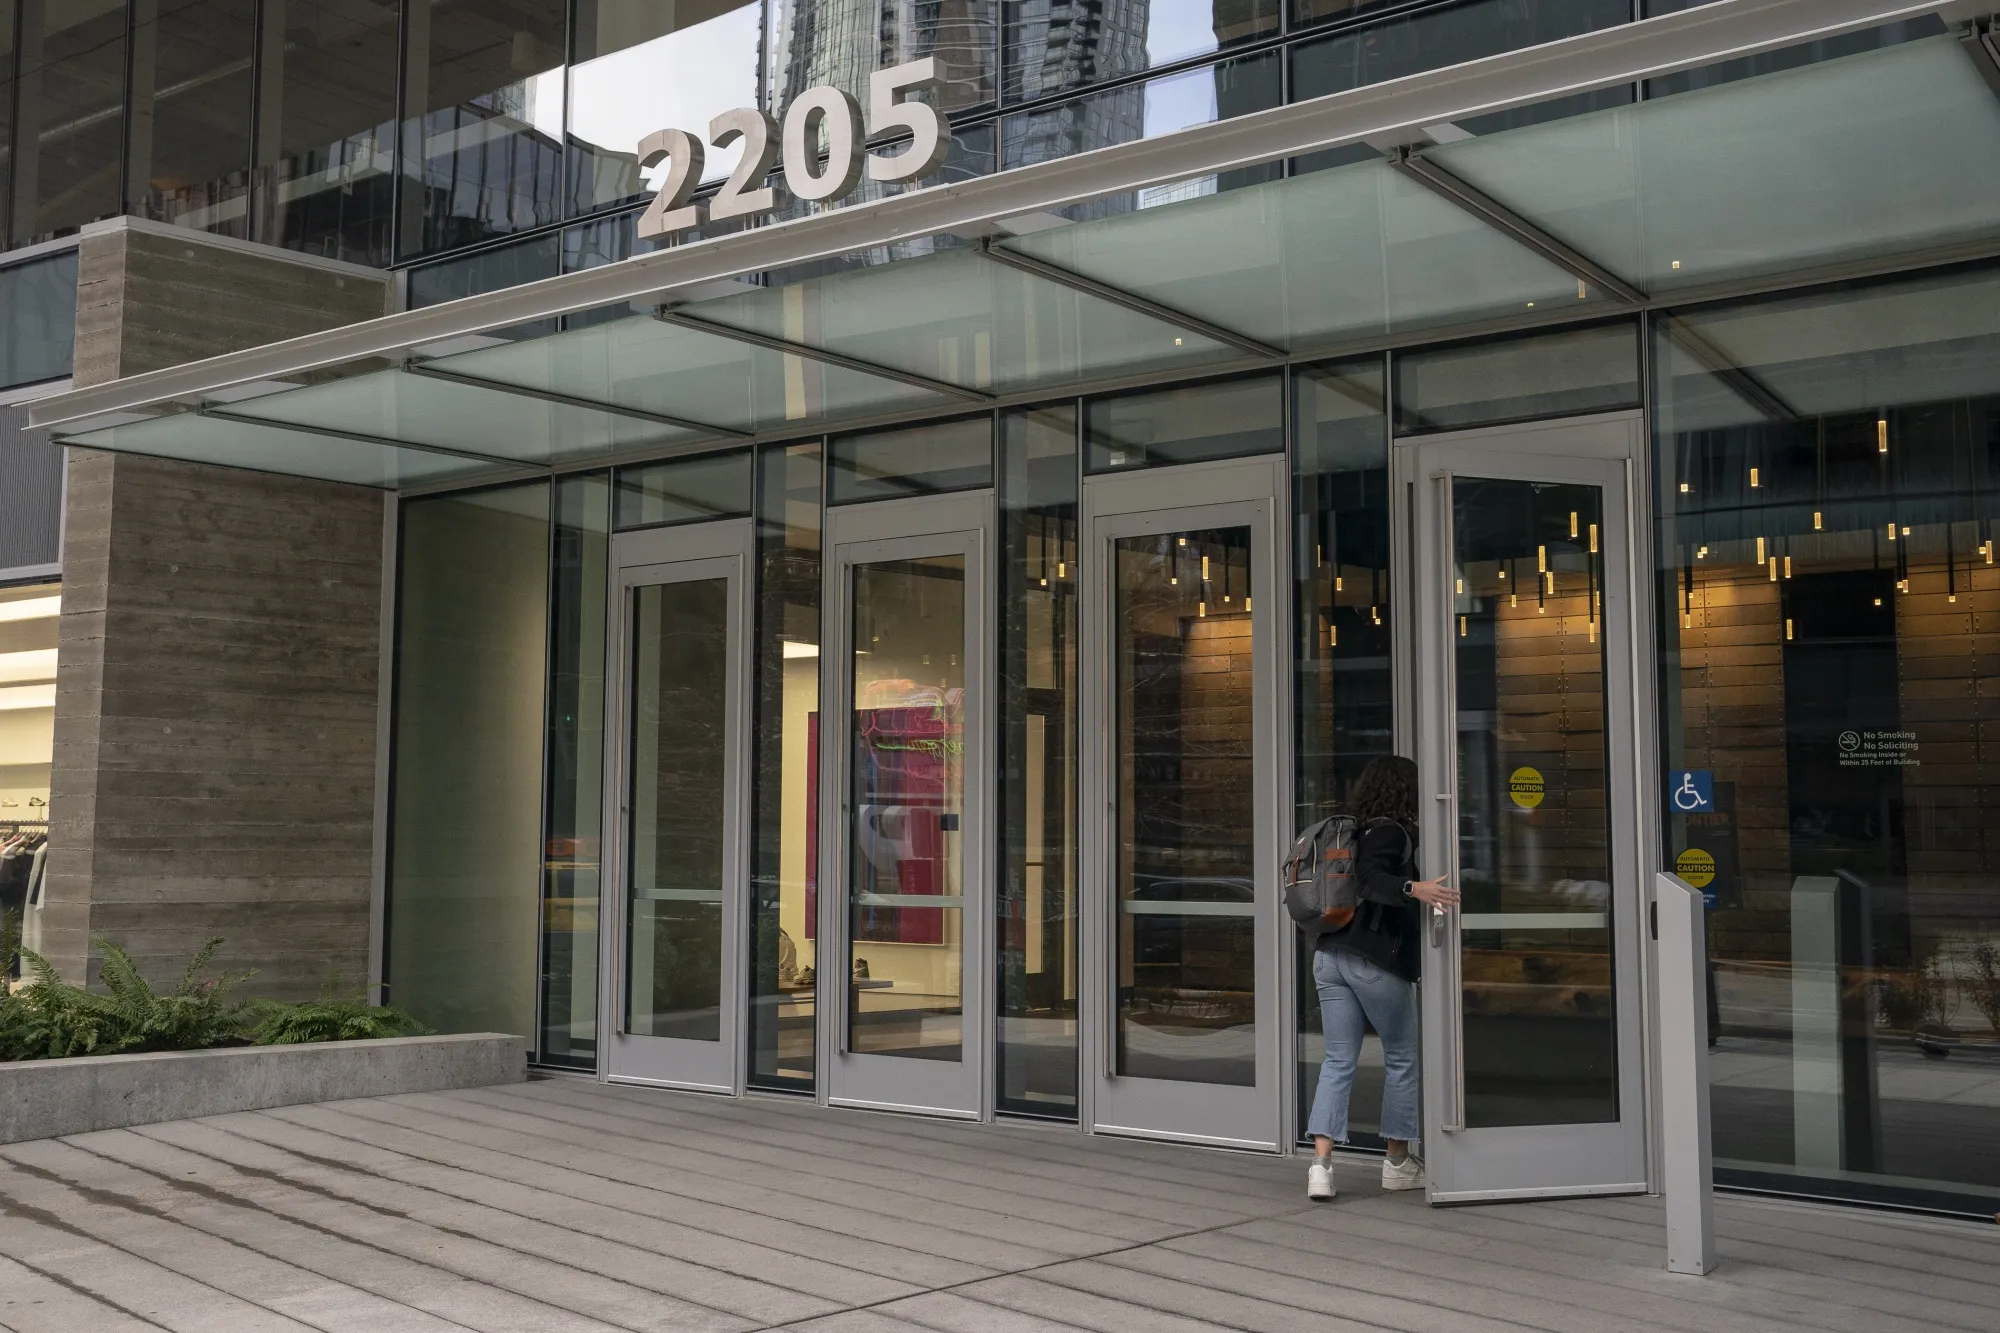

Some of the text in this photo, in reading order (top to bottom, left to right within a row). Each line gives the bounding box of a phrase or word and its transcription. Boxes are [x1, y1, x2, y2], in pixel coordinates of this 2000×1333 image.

[637, 56, 951, 240] 2205
[1878, 731, 1916, 740] Smoking
[1878, 742, 1918, 750] Soliciting
